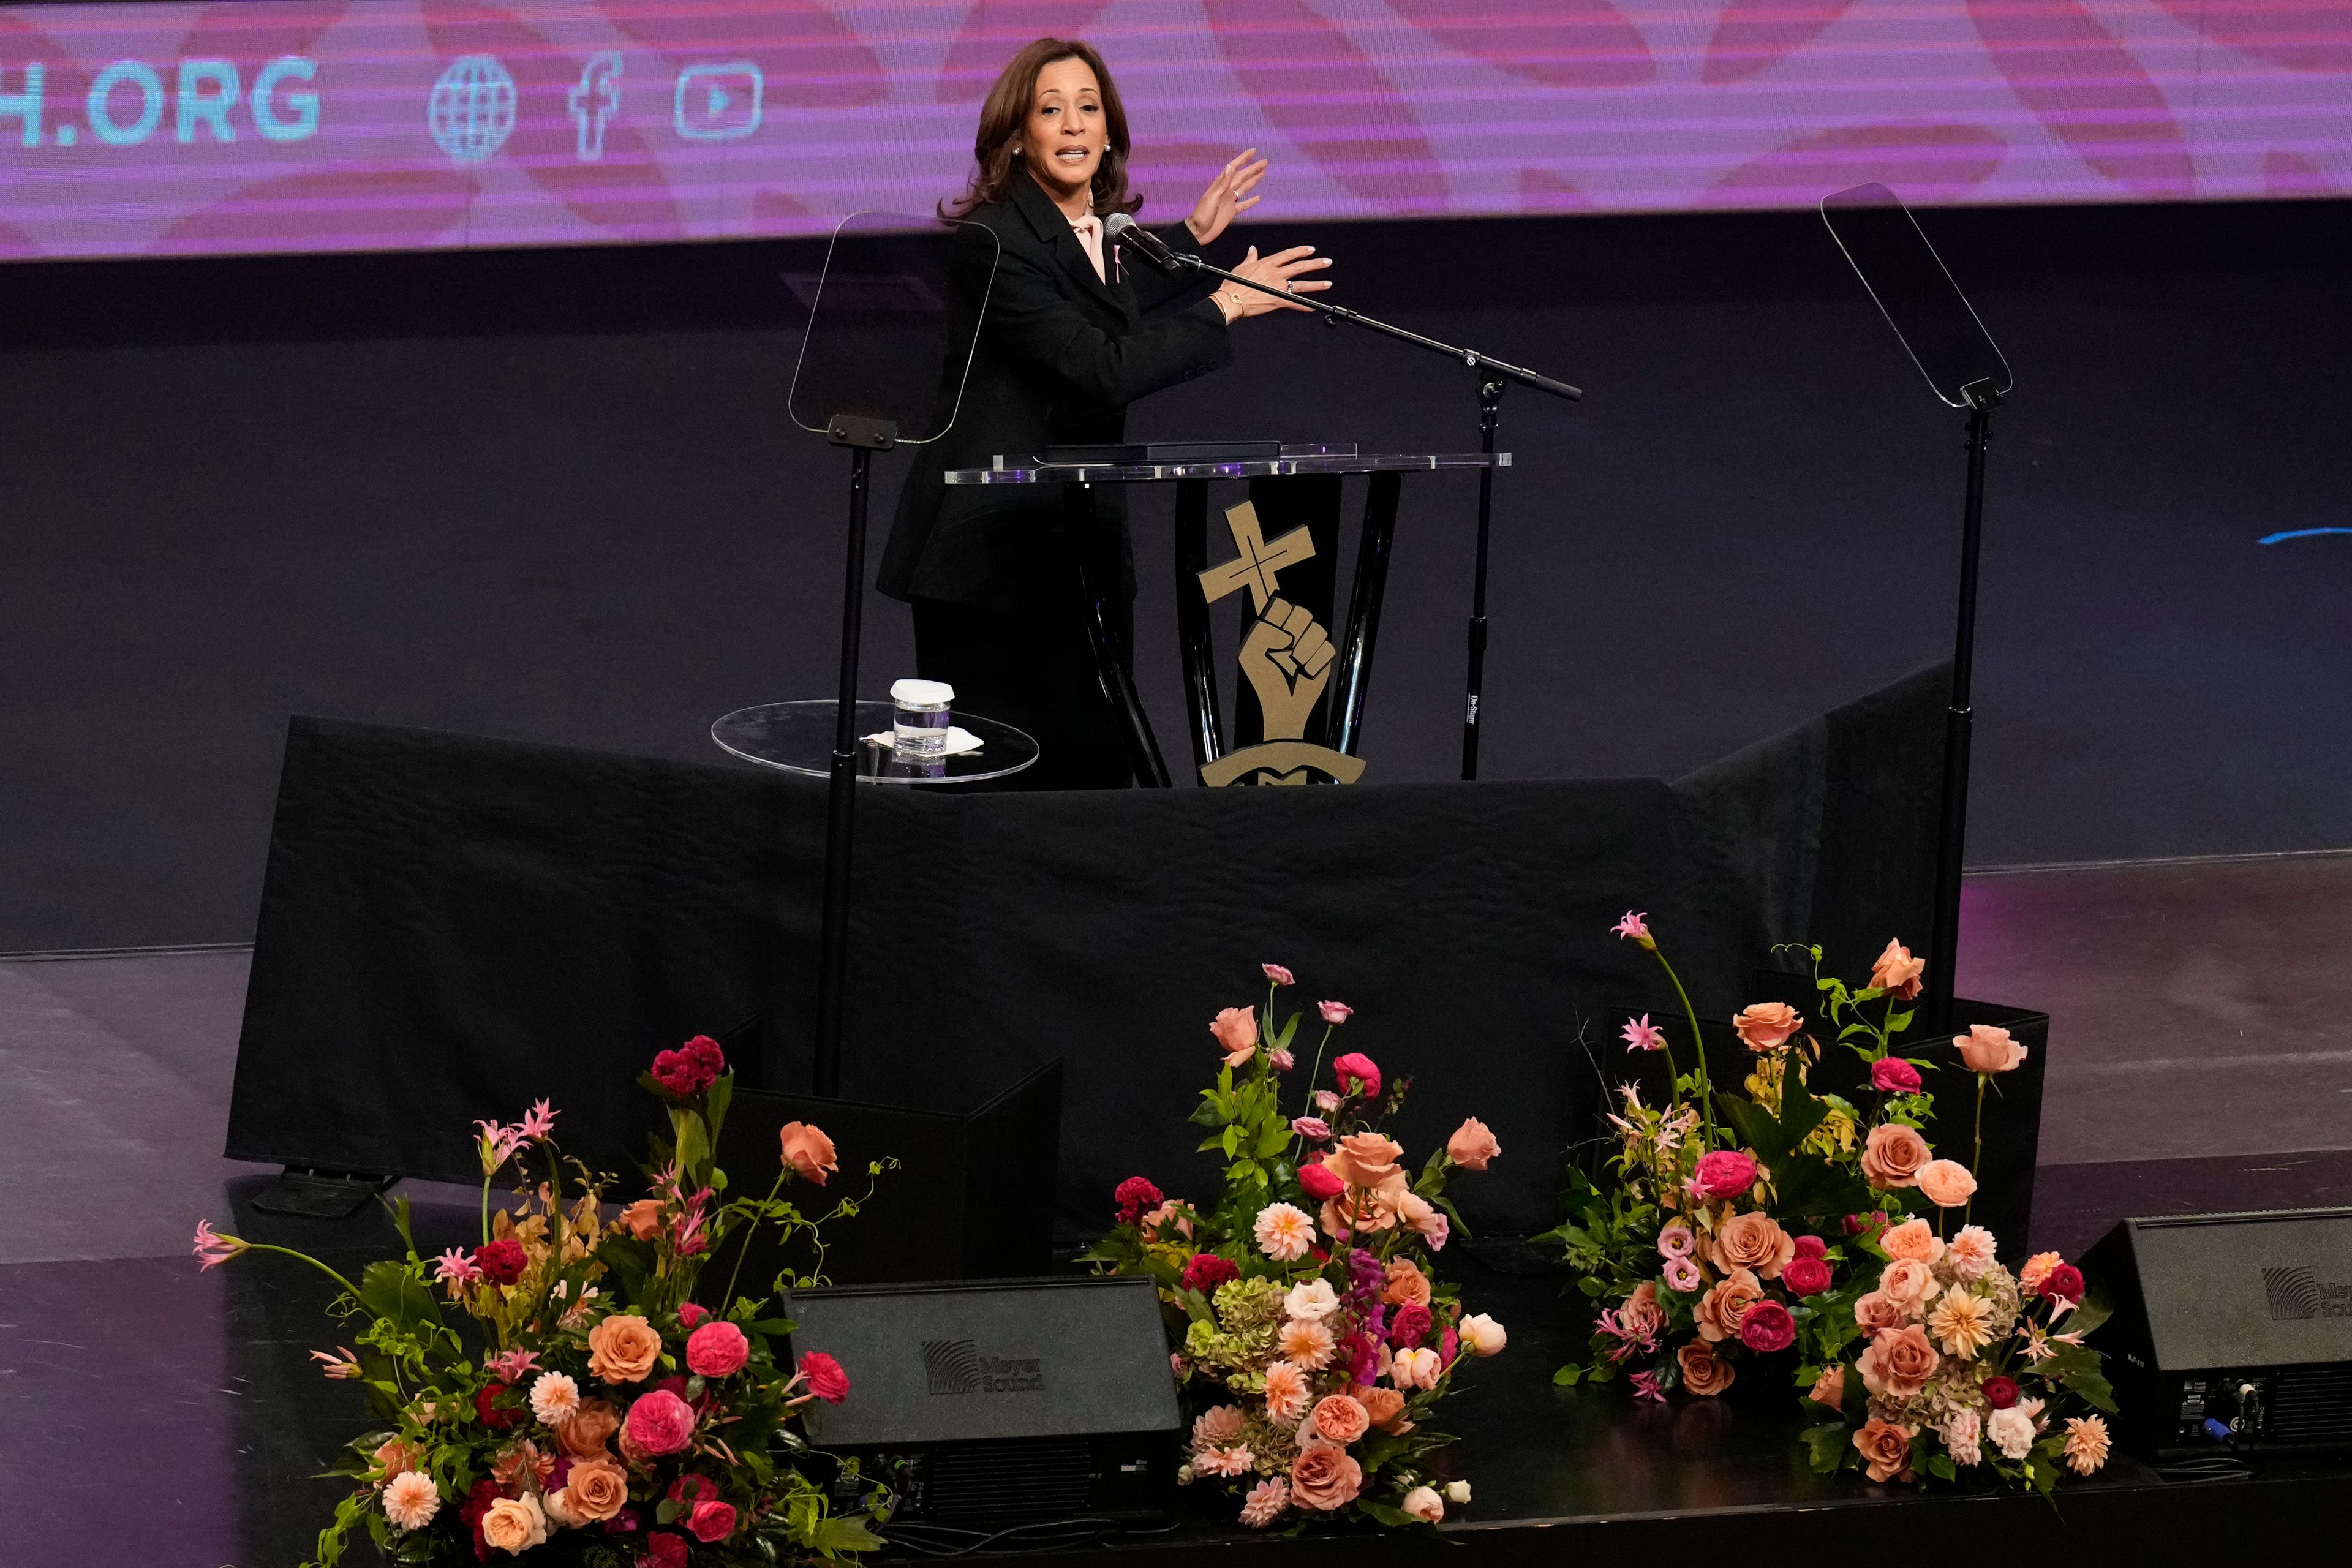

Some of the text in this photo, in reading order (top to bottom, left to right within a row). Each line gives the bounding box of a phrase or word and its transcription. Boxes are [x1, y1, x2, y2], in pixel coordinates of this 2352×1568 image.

[0, 56, 320, 147] H.ORG
[979, 1357, 1040, 1376] Meyer
[982, 1374, 1046, 1392] Sound
